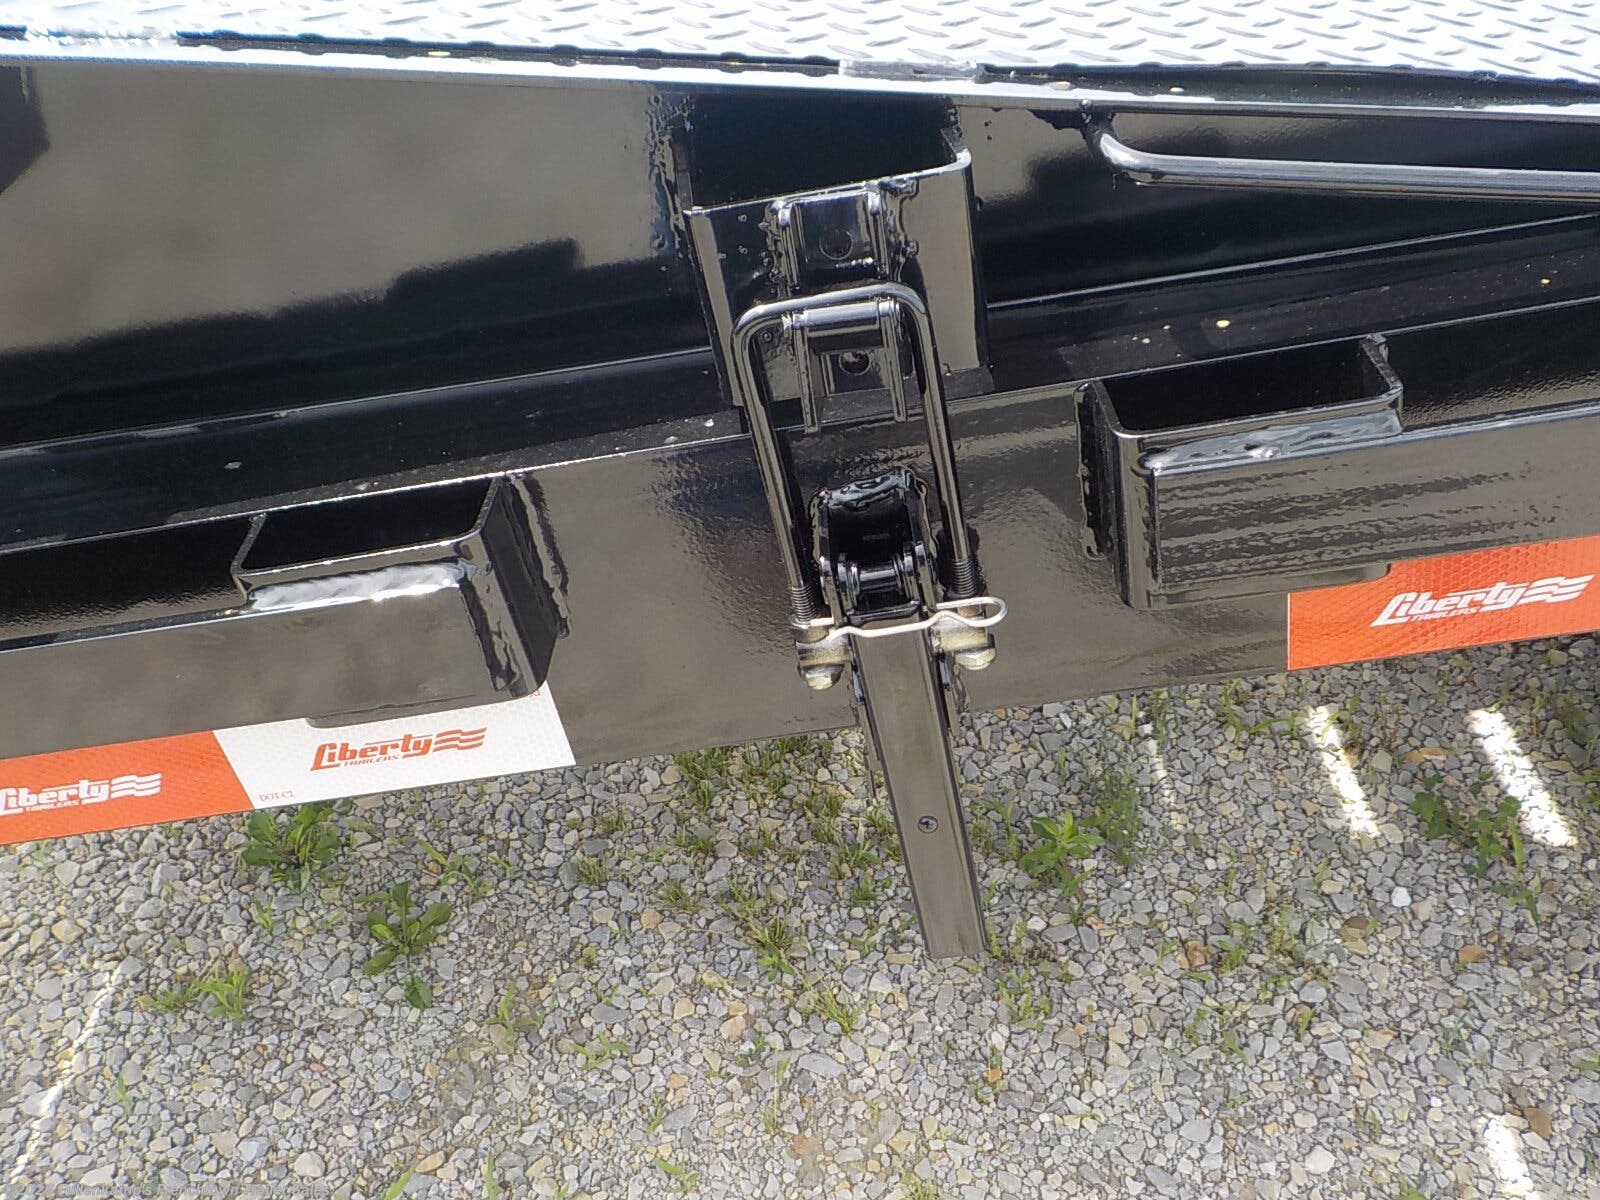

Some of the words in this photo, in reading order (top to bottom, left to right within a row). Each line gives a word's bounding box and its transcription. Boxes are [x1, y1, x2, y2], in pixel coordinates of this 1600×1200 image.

[1370, 582, 1530, 627] Liberty
[1409, 607, 1480, 622] TRAILERS
[310, 734, 433, 771] Liberty
[343, 754, 399, 767] TRAILERS
[0, 779, 110, 816] Liberty
